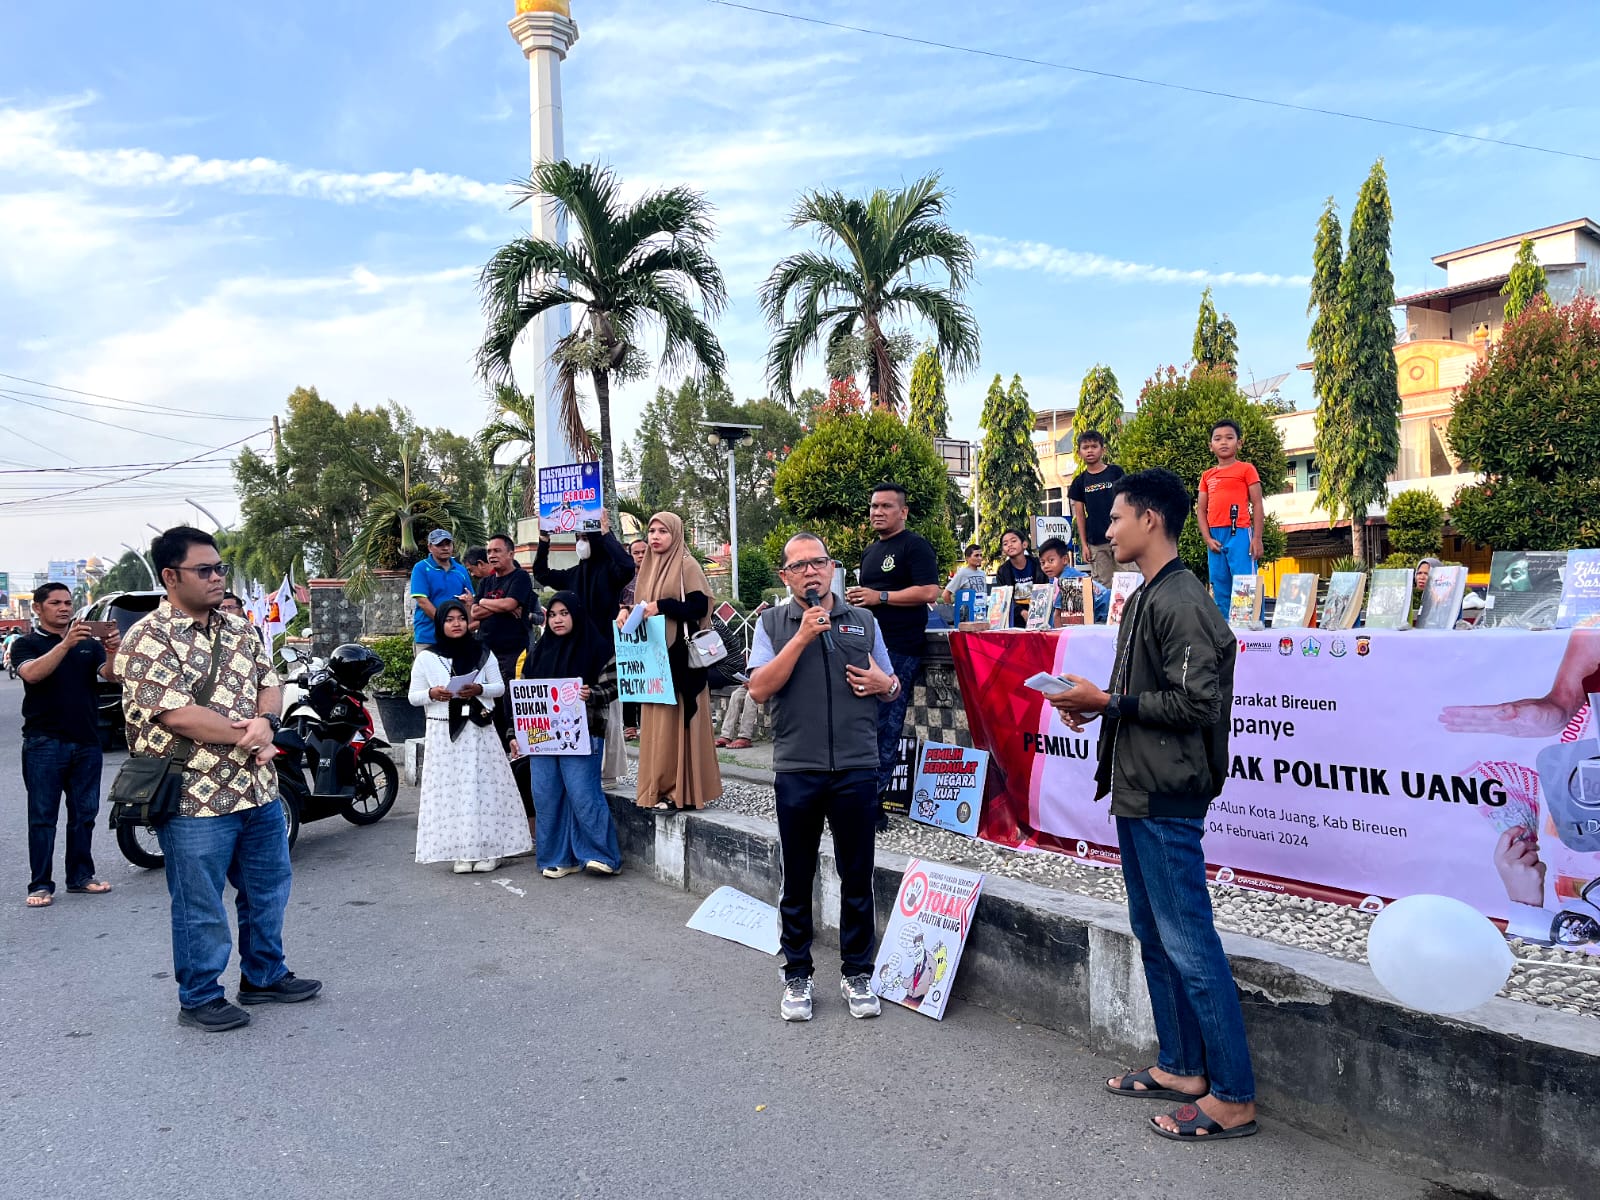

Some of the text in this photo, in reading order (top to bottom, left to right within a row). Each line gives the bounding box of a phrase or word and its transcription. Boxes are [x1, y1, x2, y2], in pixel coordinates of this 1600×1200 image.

[541, 476, 583, 494] BIREUEN
[563, 488, 595, 502] CERDAS
[513, 685, 549, 700] GOLPUT
[620, 678, 646, 695] POLITIK
[515, 701, 548, 716] BUKAN
[1281, 694, 1337, 711] Bireuen
[1229, 717, 1295, 741] panye
[1024, 731, 1089, 760] PEMILU
[926, 748, 964, 761] PEMILIH
[923, 761, 978, 775] BERDAULAT
[936, 775, 976, 787] NEGARA
[1228, 755, 1264, 782] AK
[1273, 759, 1390, 796] POLITIK
[1401, 770, 1507, 807] UANG
[934, 787, 961, 800] KUAT
[1208, 801, 1407, 838] n-Alun Kota Juang, Kab Bireuen
[1209, 821, 1223, 833] 04
[1226, 823, 1275, 842] Februari
[1278, 831, 1309, 847] 2024
[925, 889, 965, 919] TOLAK
[917, 911, 961, 932] POLITIK UANG
